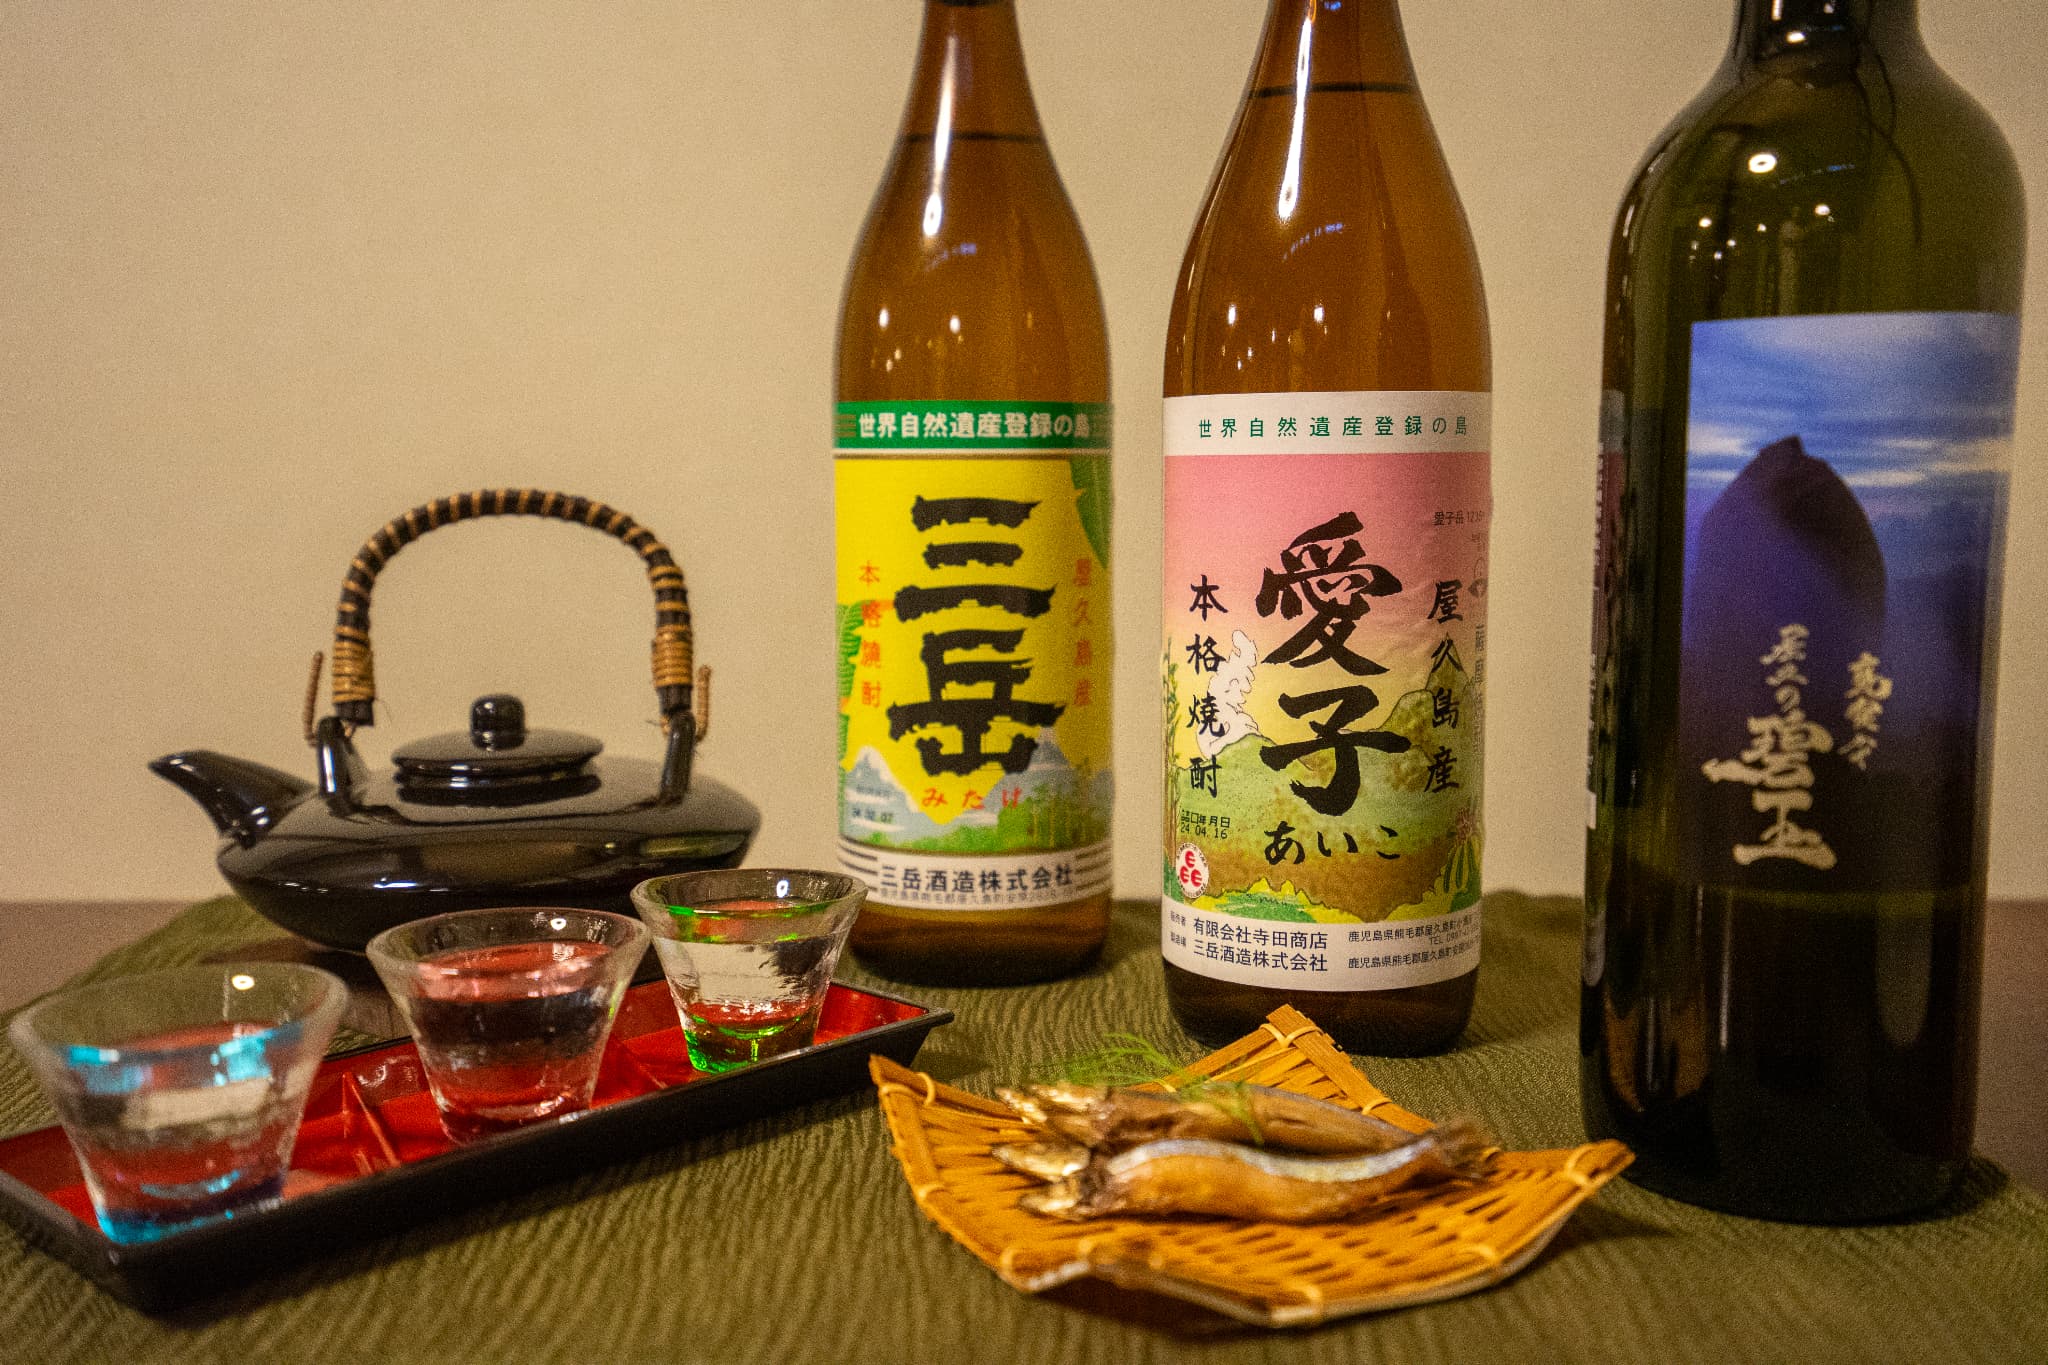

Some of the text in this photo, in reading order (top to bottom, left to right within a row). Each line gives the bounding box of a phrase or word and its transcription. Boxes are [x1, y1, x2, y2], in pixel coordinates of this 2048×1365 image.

[859, 412, 1089, 438] 世界自然遺産登録の島
[1198, 415, 1468, 439] 世界自然遺産登録の島
[886, 496, 1066, 776] 三岳
[1255, 511, 1412, 817] 愛子
[1424, 578, 1464, 793] 屋久島産
[922, 787, 1022, 810] みたけ
[1264, 820, 1401, 865] あいこ
[881, 863, 1073, 893] 三岳酒造株式会社
[1193, 916, 1329, 950] 有限会社寺田商店
[1193, 938, 1329, 972] 三岳酒造株式会社
